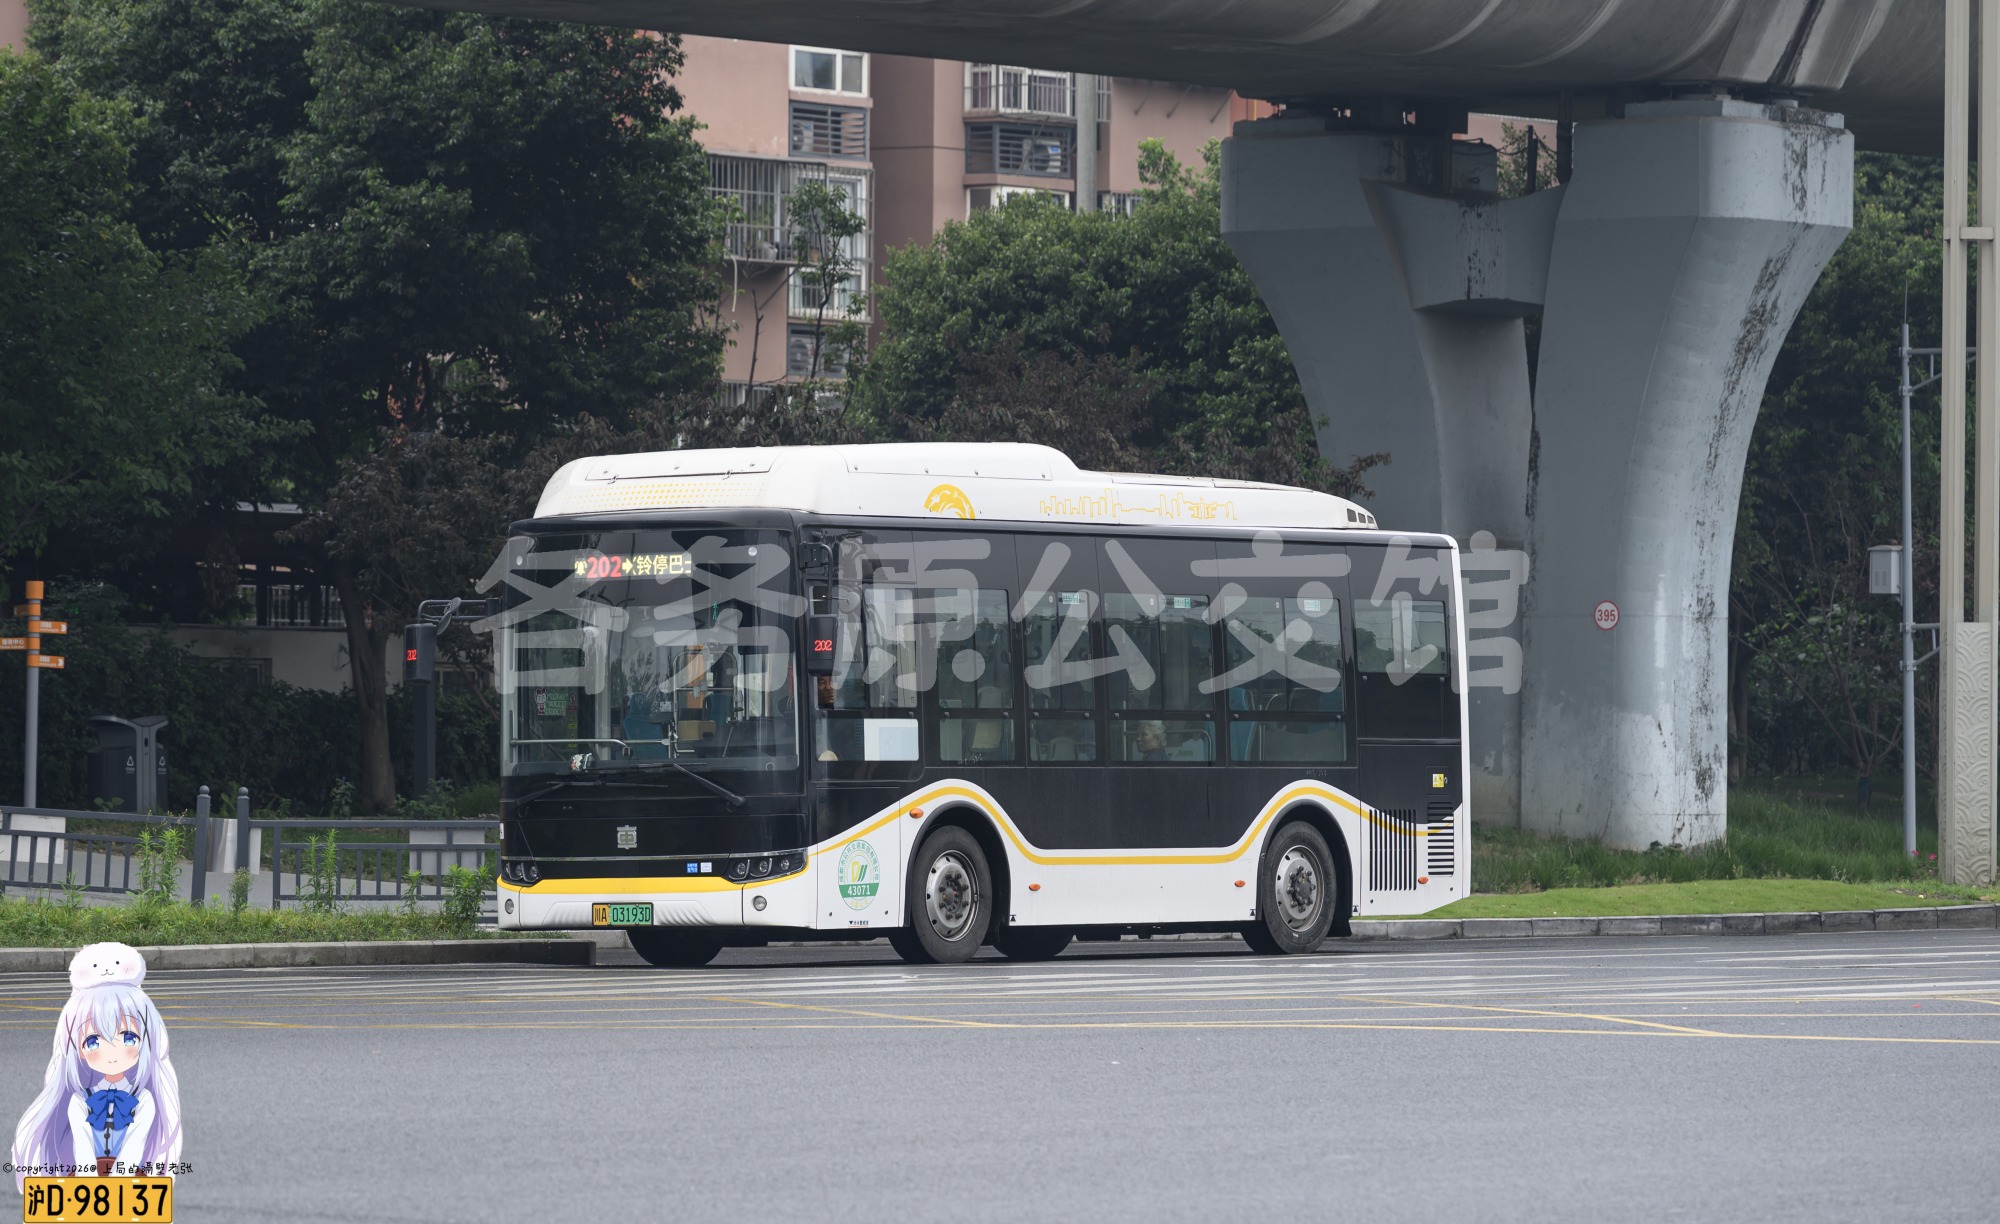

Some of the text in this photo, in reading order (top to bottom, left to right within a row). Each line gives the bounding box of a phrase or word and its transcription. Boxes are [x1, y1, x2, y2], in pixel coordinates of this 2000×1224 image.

[586, 555, 622, 579] 202
[1597, 609, 1616, 622] 395
[814, 639, 833, 651] 202
[847, 885, 871, 896] 43071
